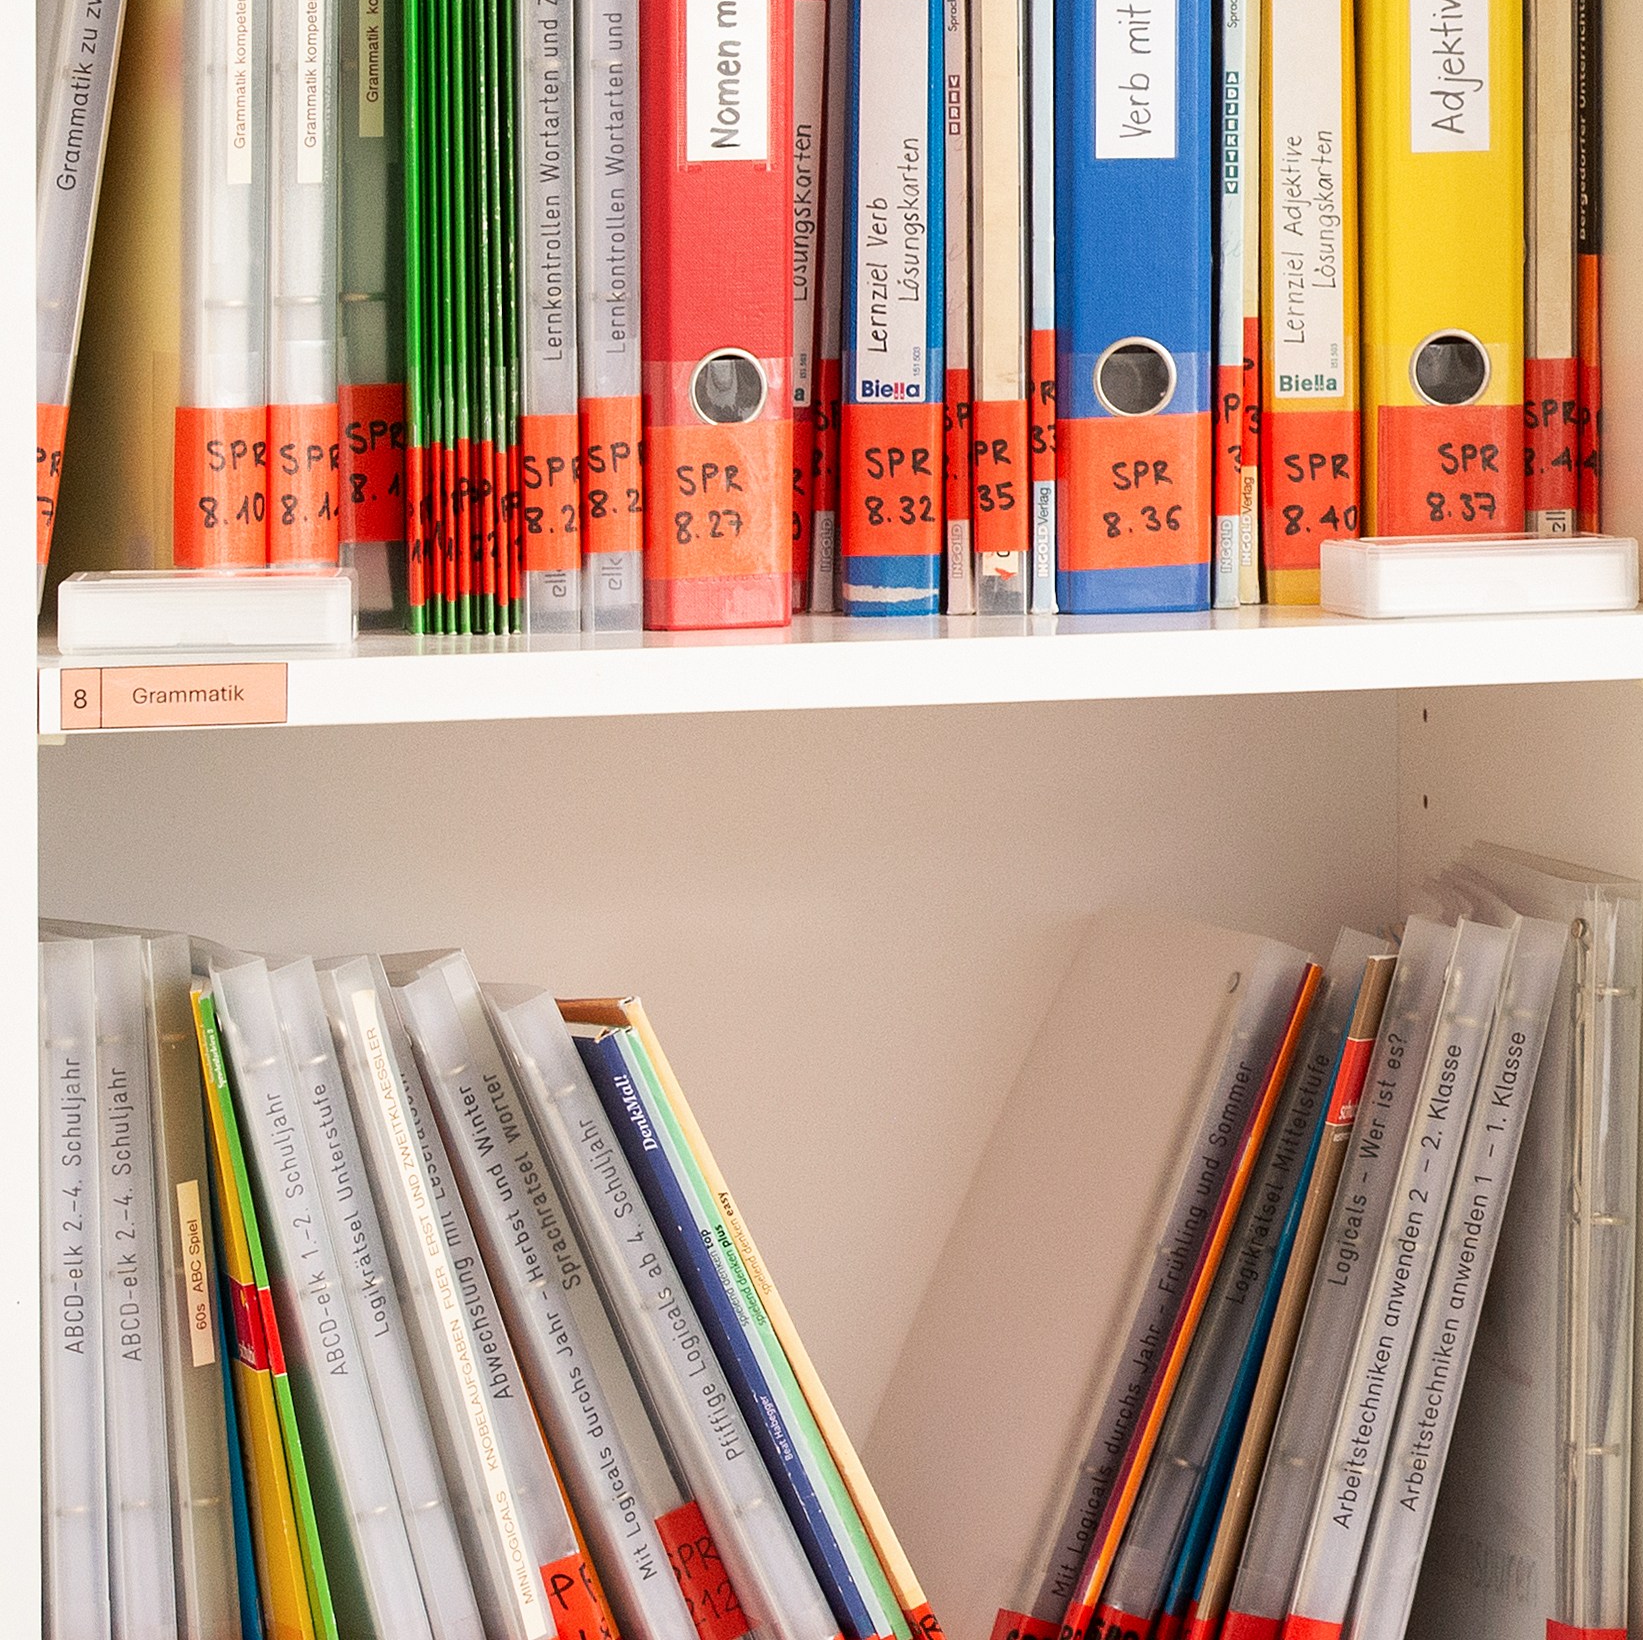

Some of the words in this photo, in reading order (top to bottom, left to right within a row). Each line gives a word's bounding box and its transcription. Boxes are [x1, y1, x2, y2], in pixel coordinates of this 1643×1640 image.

[539, 18, 558, 56] und
[1118, 3, 1150, 54] mit
[366, 25, 380, 102] Grammatik
[54, 61, 94, 192] Grammatik
[79, 26, 99, 54] zu
[233, 70, 246, 148] Grammatik
[710, 40, 740, 147] Nomen
[948, 74, 960, 134] VERB
[1118, 73, 1151, 138] Verb
[539, 69, 560, 182] Wortarten
[1224, 70, 1238, 194] ADJEKTIV
[1282, 135, 1310, 235] Adjektive
[866, 197, 887, 246] Verb
[541, 195, 562, 360] Lernkontrollen
[1281, 252, 1304, 342] Lernziel
[865, 263, 887, 352] Lernziel
[861, 380, 920, 400] Biella
[1279, 374, 1338, 392] Biella
[345, 420, 405, 456] SPR
[1524, 399, 1577, 429] SPR
[207, 439, 266, 472] SPR
[676, 462, 743, 496] SPR
[864, 447, 932, 480] SPR
[1112, 460, 1173, 491] SPR
[1284, 453, 1349, 483] SPR
[1437, 442, 1499, 475] SPR
[199, 492, 265, 528] 8.10
[674, 510, 743, 545] 8.27
[864, 495, 936, 526] 8.32
[1103, 505, 1182, 539] 8.36
[1282, 505, 1357, 536] 8.40
[1426, 491, 1496, 522] 8.37
[951, 524, 962, 578] INGOLD
[73, 689, 88, 709] 8
[132, 684, 245, 705] Grammatik
[364, 1025, 416, 1171] ZWEITKLAESSLER
[1427, 1042, 1463, 1121] Klasse
[454, 1081, 495, 1156] Winter
[613, 1071, 658, 1153] DenkMal!
[261, 1089, 309, 1198] Schuljahr
[309, 1082, 356, 1202] Unterstufe
[1420, 1127, 1443, 1151] 2.
[406, 1172, 426, 1209] UND
[484, 1162, 514, 1204] und
[573, 1113, 636, 1219] Schuljahr
[717, 1189, 736, 1217] easy
[1408, 1186, 1429, 1204] 2
[186, 1219, 201, 1254] Spiel
[418, 1211, 440, 1256] ERST
[502, 1208, 544, 1282] Herbst
[624, 1222, 647, 1245] 4.
[728, 1217, 752, 1255] denken
[190, 1259, 203, 1293] ABC
[343, 1211, 393, 1337] Logikrätsel
[433, 1264, 455, 1310] FUER
[637, 1250, 664, 1280] ab
[745, 1253, 773, 1296] spielend
[1379, 1209, 1424, 1327] anwenden
[194, 1303, 206, 1329] 60s
[306, 1269, 349, 1377] ABCD-elk
[541, 1308, 574, 1361] Jahr
[653, 1283, 710, 1376] Logicals
[448, 1318, 500, 1471] KNOBELAUFGABEN
[563, 1365, 604, 1440] durchs
[696, 1380, 748, 1460] Pfiffige
[1330, 1332, 1396, 1529] Arbeitstechniken
[593, 1444, 645, 1538] Logicals
[494, 1489, 536, 1604] MINILOGICALS
[630, 1542, 659, 1581] Mit
